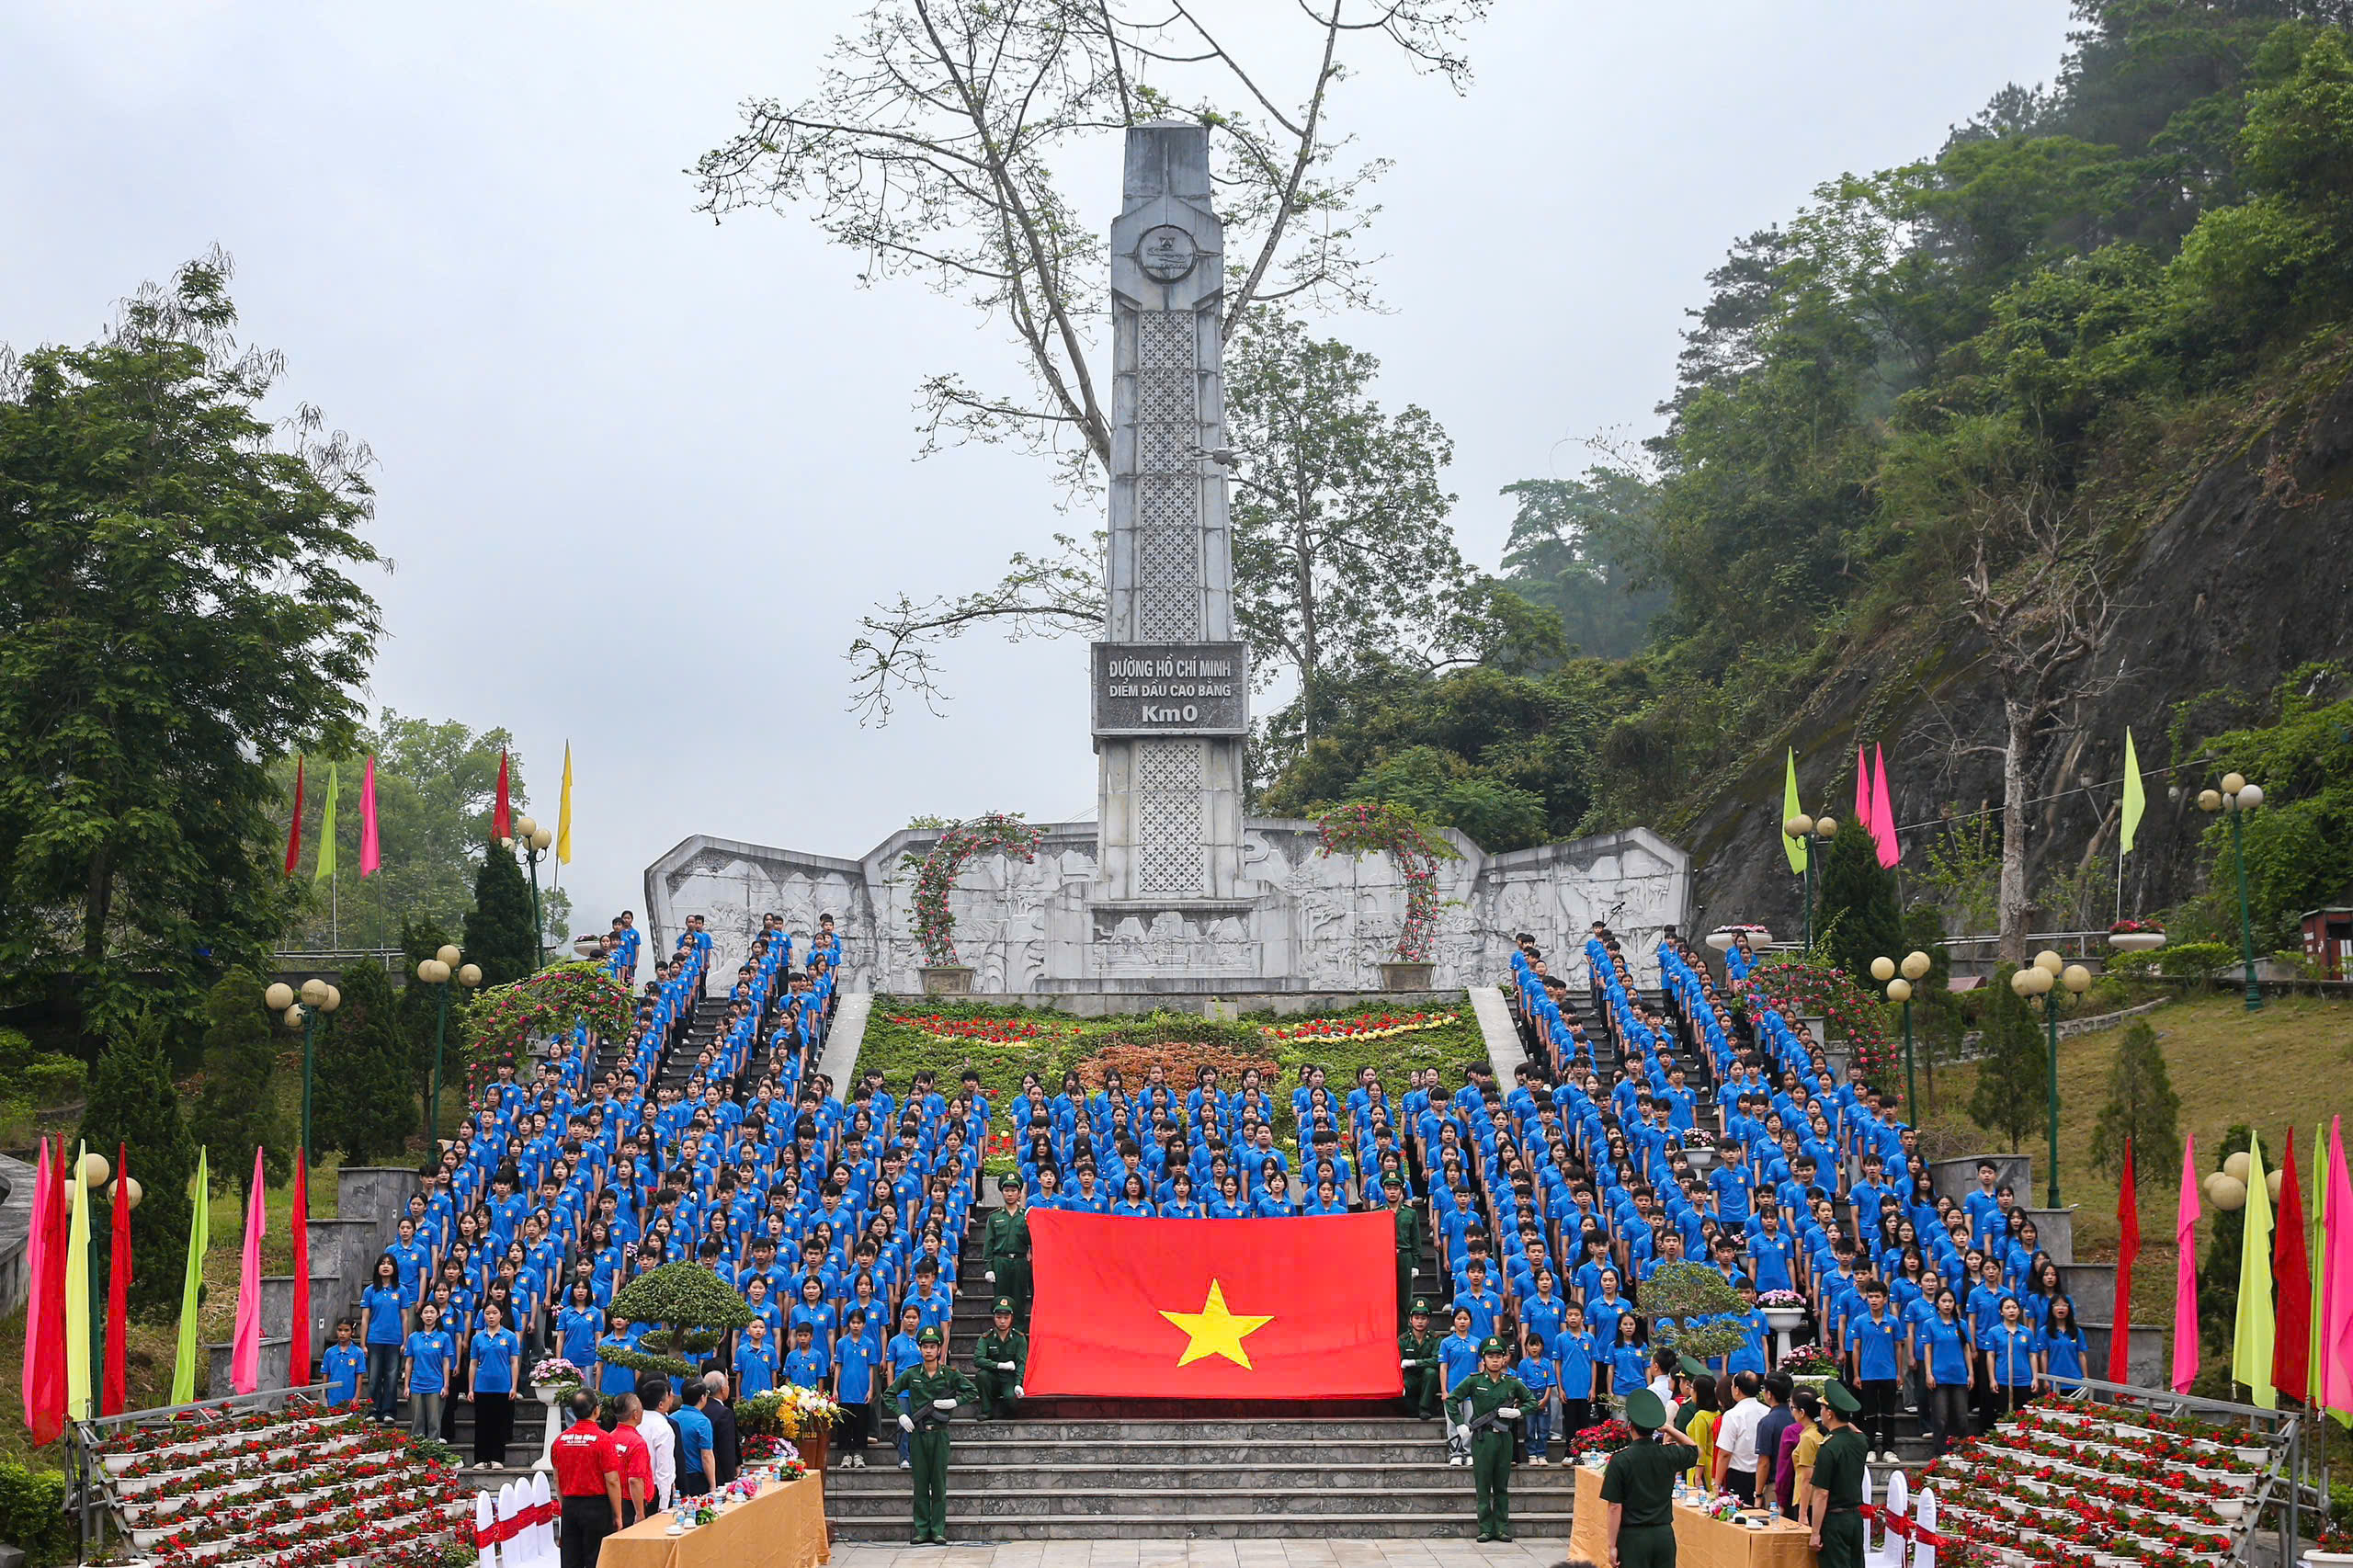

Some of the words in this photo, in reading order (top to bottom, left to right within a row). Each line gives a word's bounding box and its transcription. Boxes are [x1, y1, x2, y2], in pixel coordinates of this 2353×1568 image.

[1108, 656, 1153, 677] ĐƯỜNG
[1156, 653, 1174, 677] HỒ
[1176, 655, 1197, 677] CHÍ
[1199, 660, 1231, 677] MINH
[1109, 678, 1138, 697] ĐIỂM
[1142, 679, 1166, 697] ĐẦU
[1170, 685, 1195, 697] CAO
[1198, 678, 1231, 697] BẰNG
